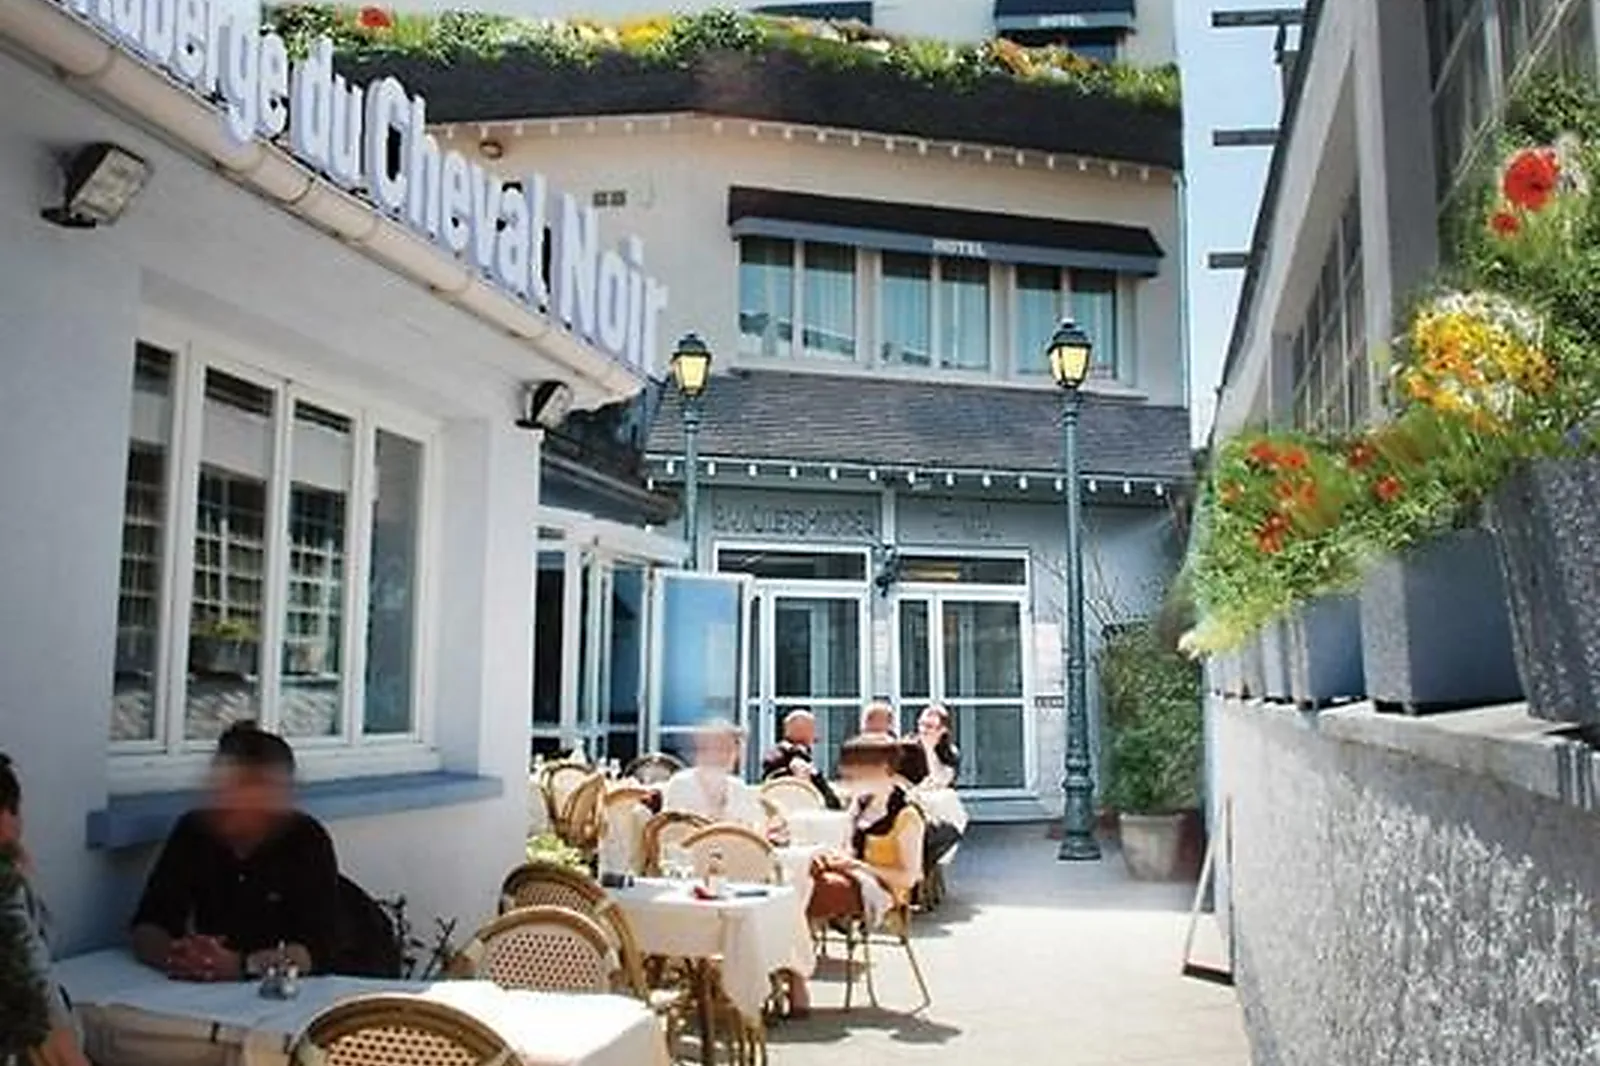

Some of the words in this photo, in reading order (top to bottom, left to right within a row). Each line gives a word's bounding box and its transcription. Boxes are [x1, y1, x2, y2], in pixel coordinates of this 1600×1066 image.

[66, 0, 288, 142] erge
[292, 34, 365, 182] du
[365, 76, 548, 302] Cheval
[555, 191, 668, 372] Noir
